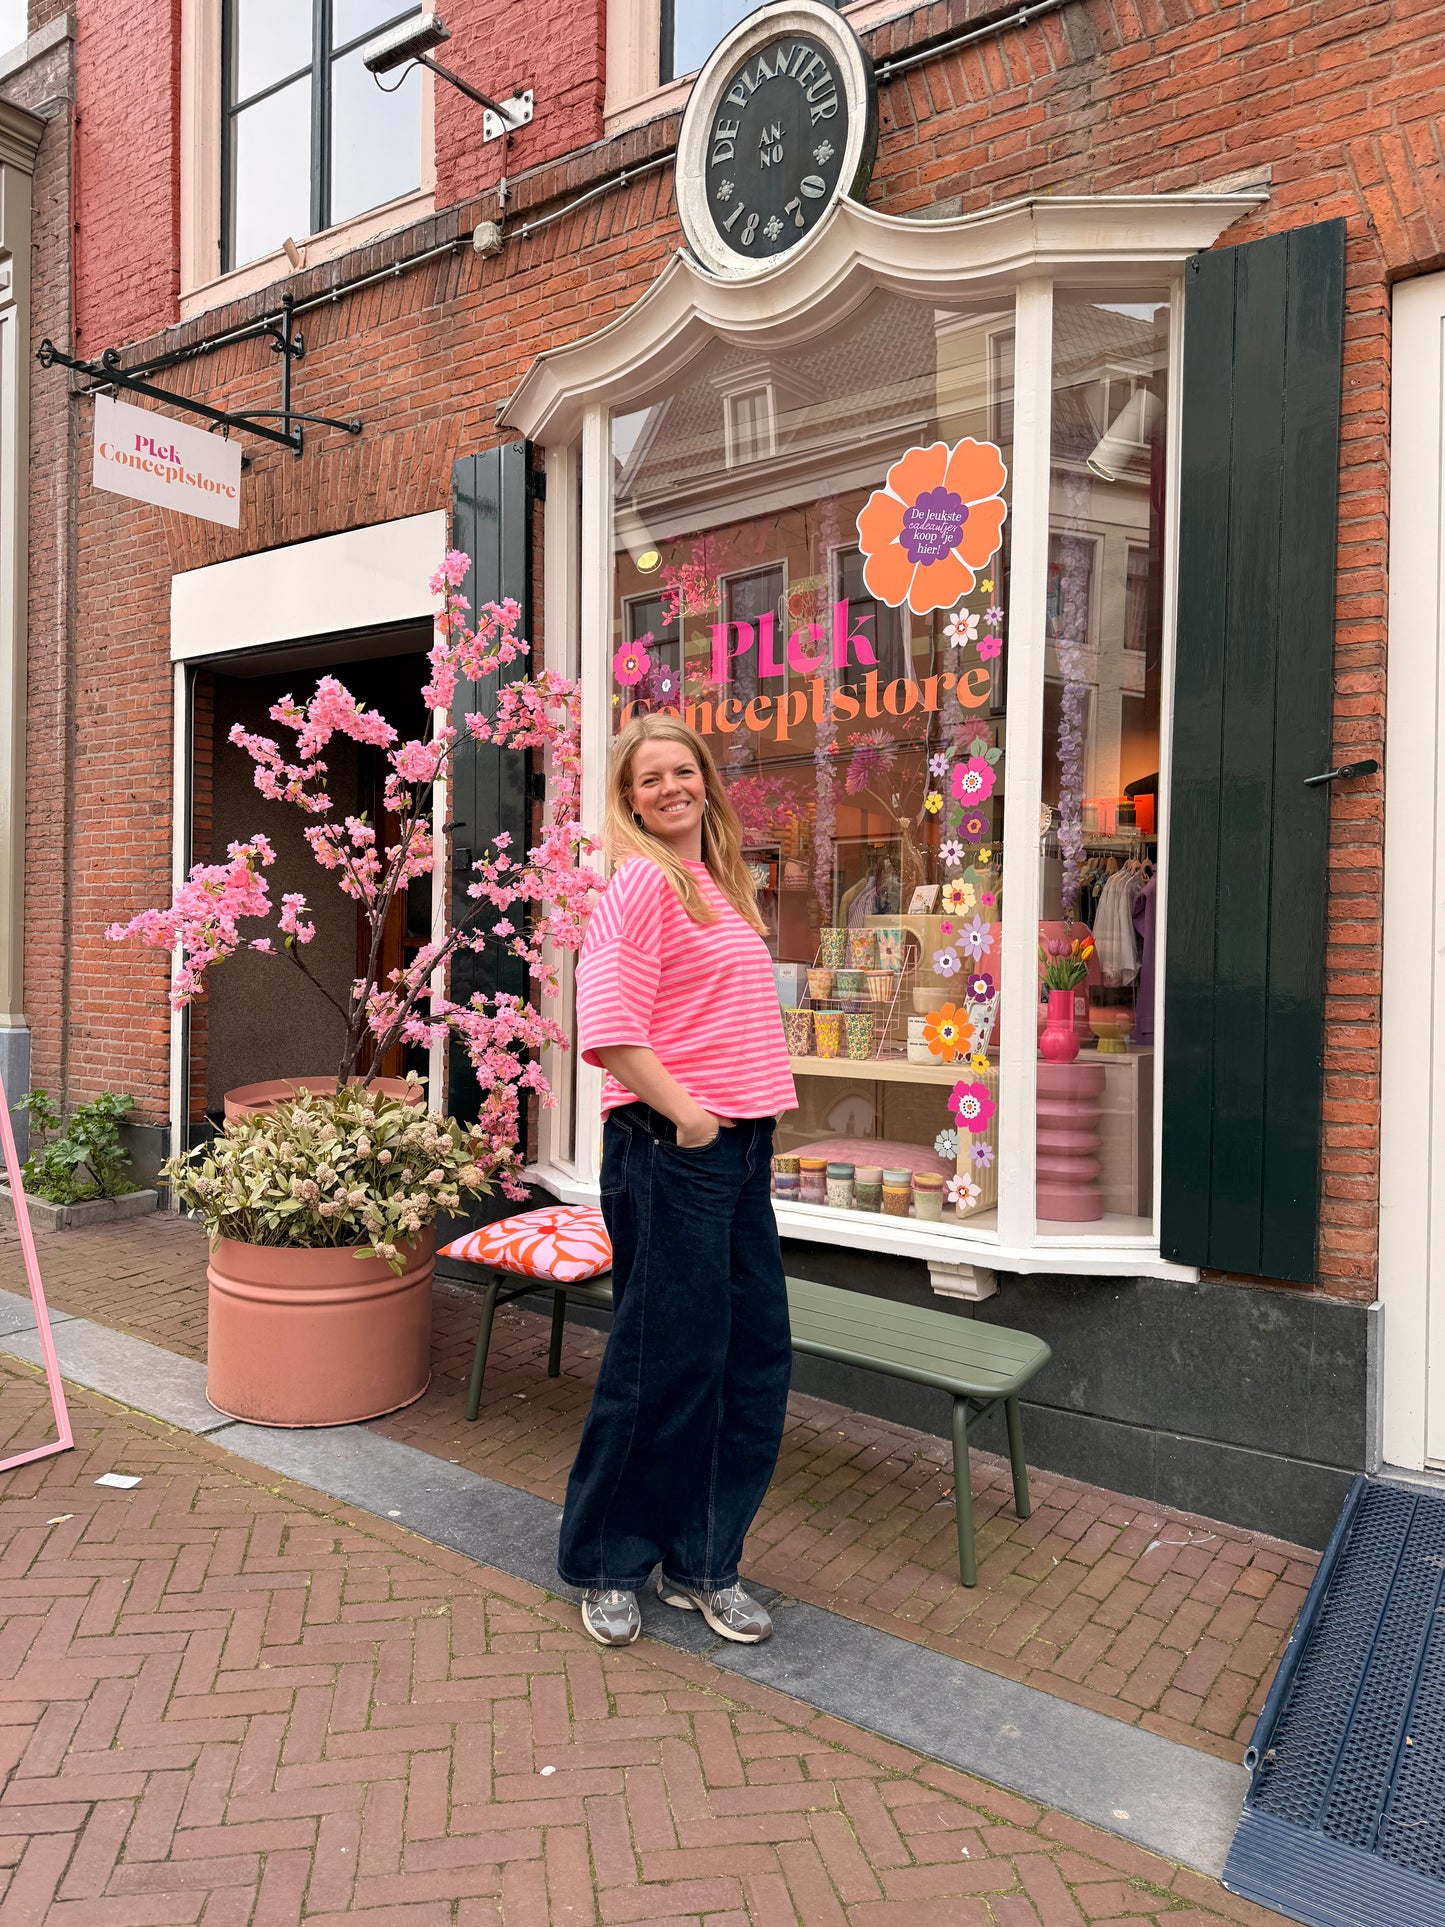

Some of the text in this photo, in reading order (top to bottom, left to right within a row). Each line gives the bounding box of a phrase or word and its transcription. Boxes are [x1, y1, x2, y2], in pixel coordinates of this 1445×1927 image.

[712, 45, 838, 168] DE PLANTEUR
[760, 145, 784, 169] NO
[135, 434, 182, 465] Plek
[99, 442, 236, 499] Conceptstore
[911, 508, 962, 522] De leukste
[908, 519, 958, 539] cadeautjes
[913, 529, 953, 545] koop je
[917, 543, 941, 555] hier!
[706, 598, 880, 684] Plek
[619, 668, 991, 742] Cnceptstore
